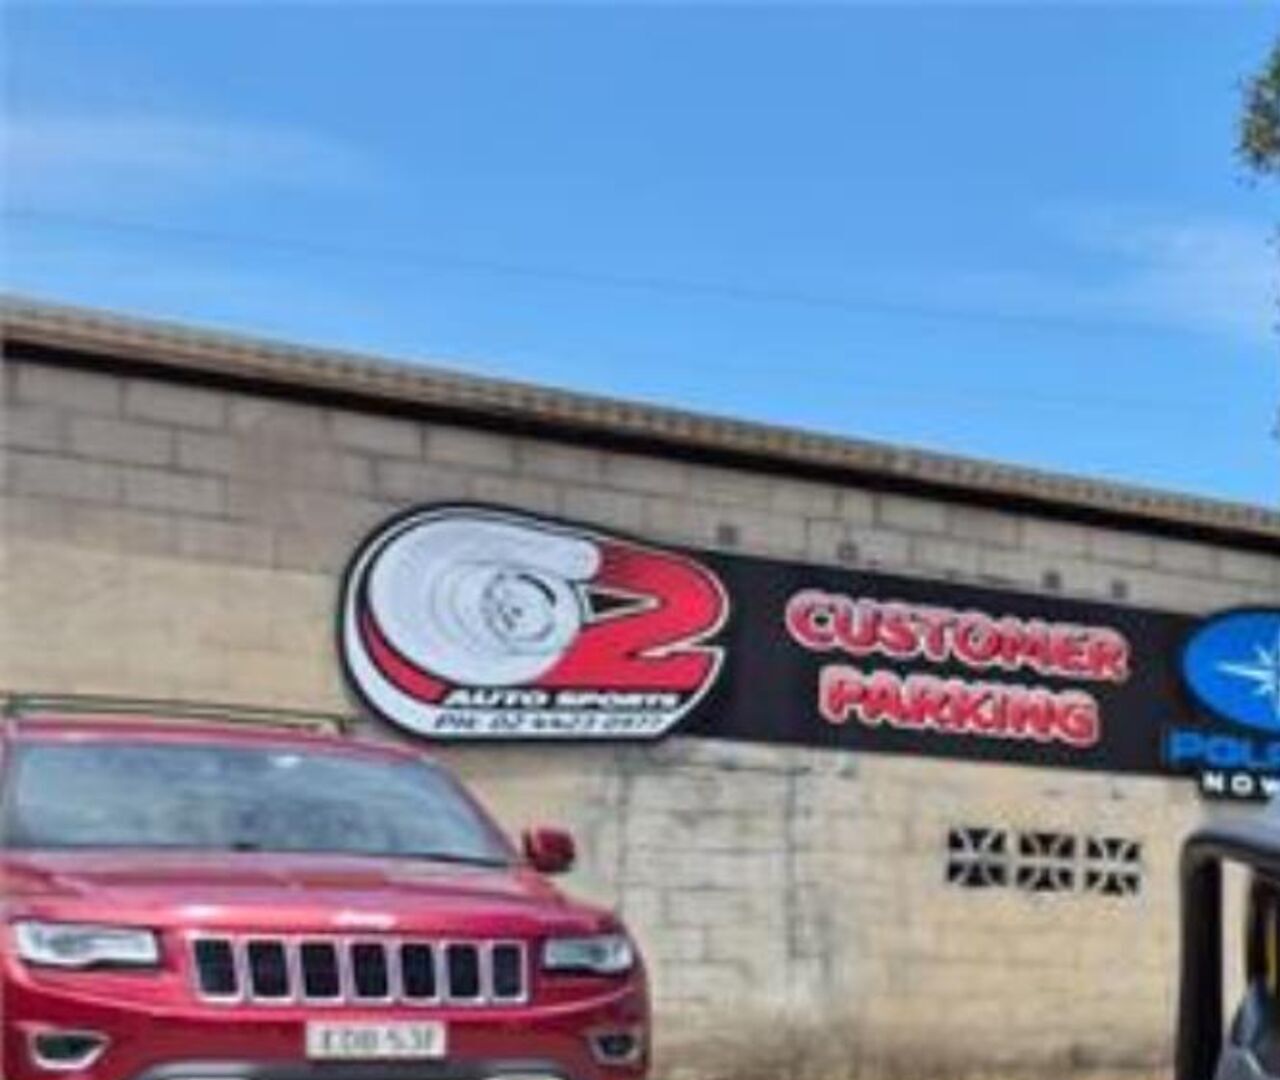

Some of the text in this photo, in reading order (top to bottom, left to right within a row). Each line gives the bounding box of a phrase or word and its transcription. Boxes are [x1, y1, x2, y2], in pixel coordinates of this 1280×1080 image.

[785, 589, 1129, 681] CUSTOMER
[443, 688, 682, 709] AUTO SPORTS
[818, 664, 1100, 747] PARKING
